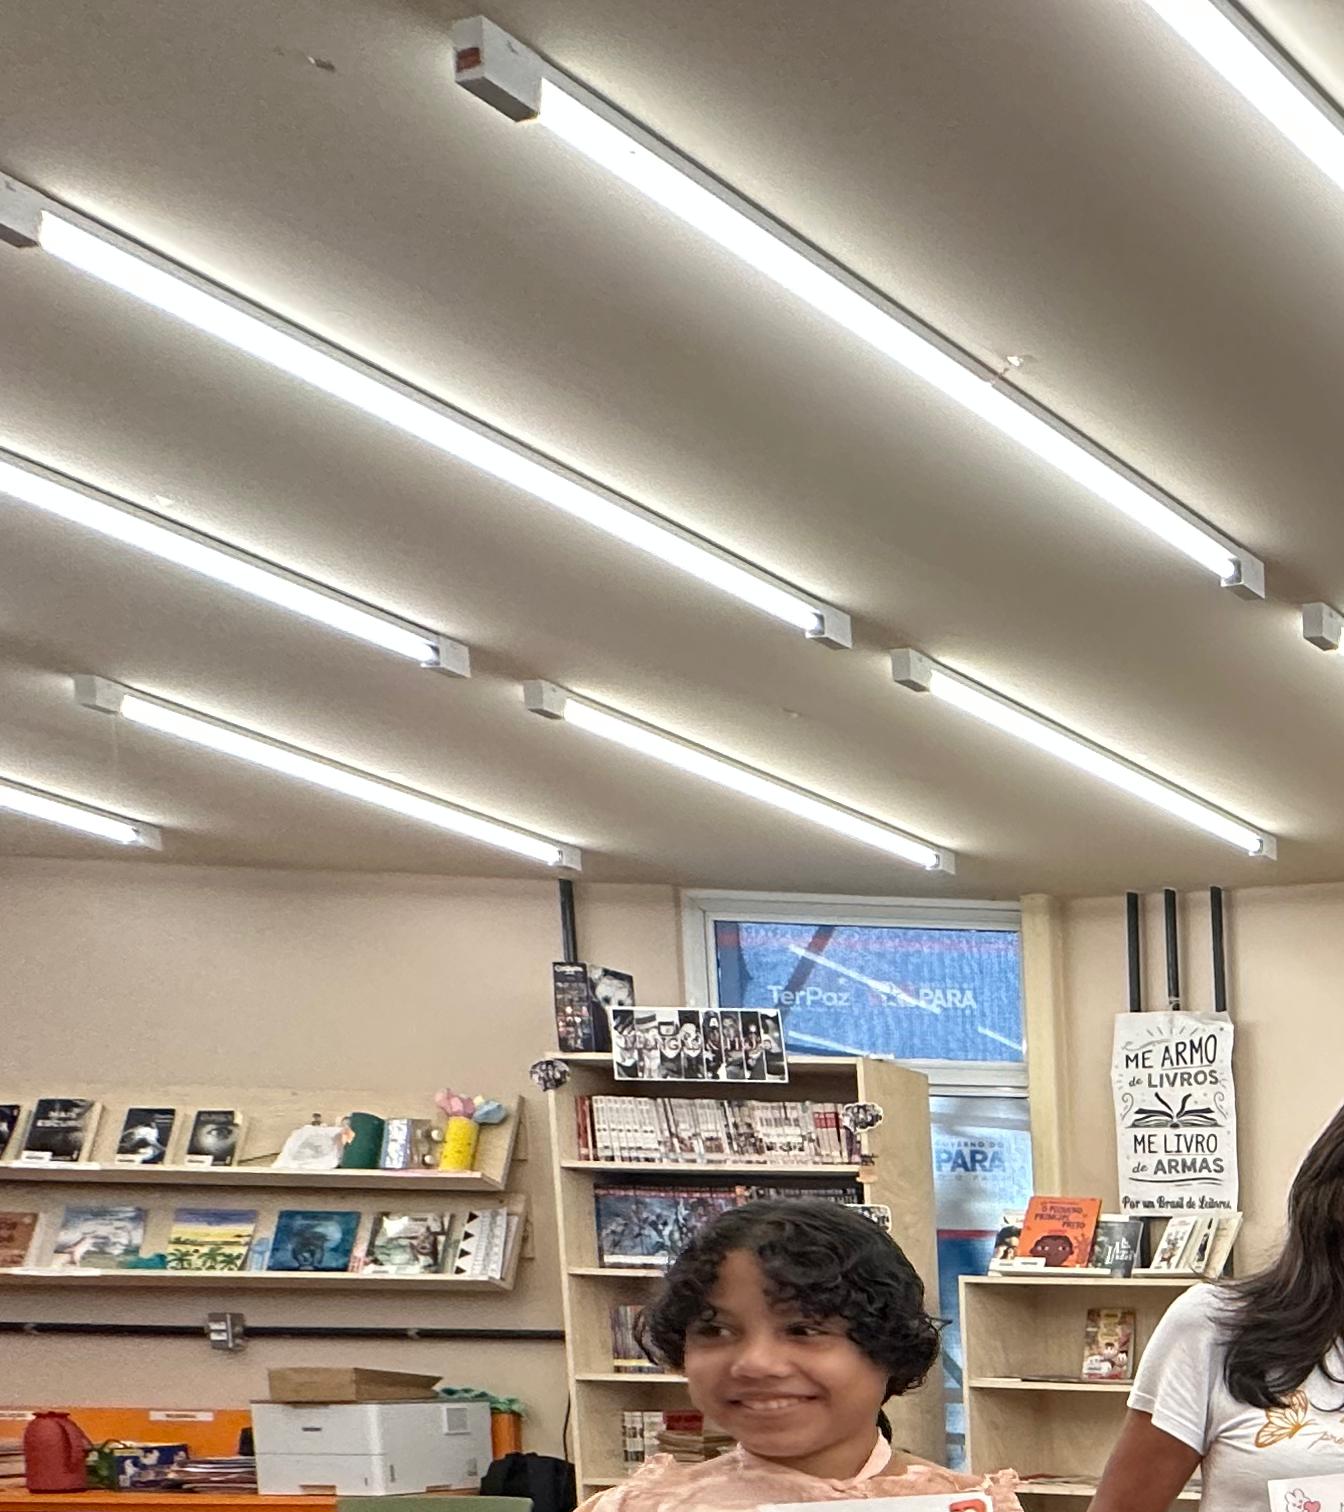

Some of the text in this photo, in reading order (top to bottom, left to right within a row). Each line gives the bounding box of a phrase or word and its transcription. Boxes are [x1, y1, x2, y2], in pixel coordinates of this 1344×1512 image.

[767, 985, 851, 1008] TerPaz
[1125, 1034, 1218, 1069] ME ARMO
[1128, 1069, 1219, 1088] de LIVROS
[1133, 1133, 1218, 1154] ME LIVRO
[1132, 1158, 1224, 1175] de ARMAS
[1122, 1195, 1141, 1209] Por
[1156, 1195, 1184, 1209] Brasil
[1186, 1195, 1196, 1209] de
